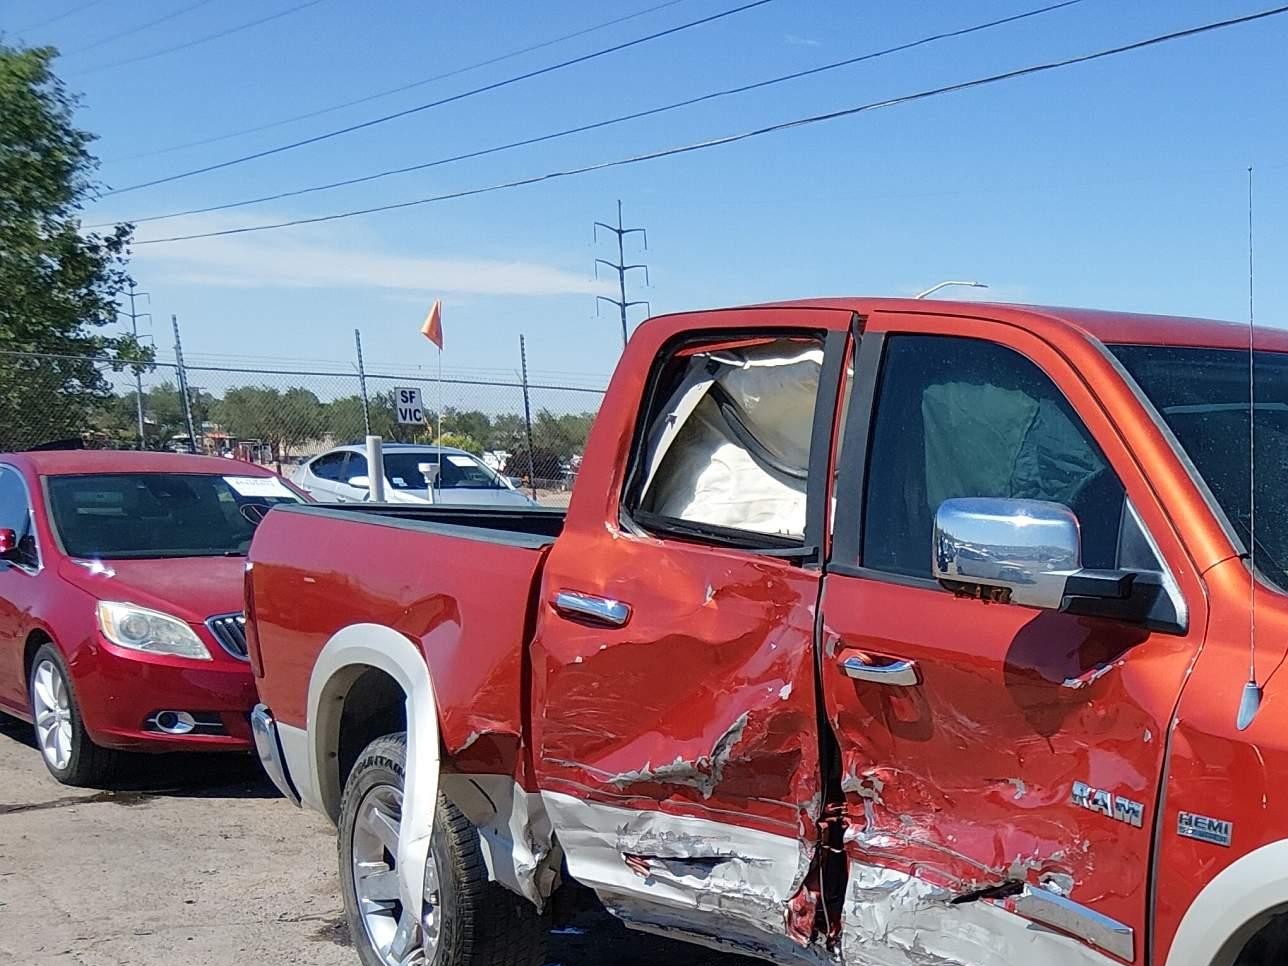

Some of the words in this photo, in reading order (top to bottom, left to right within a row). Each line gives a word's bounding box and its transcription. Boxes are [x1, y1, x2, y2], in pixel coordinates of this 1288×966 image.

[400, 390, 416, 404] SF
[399, 407, 422, 422] VIC
[1071, 780, 1145, 828] RAM
[1179, 813, 1230, 835] HEMI
